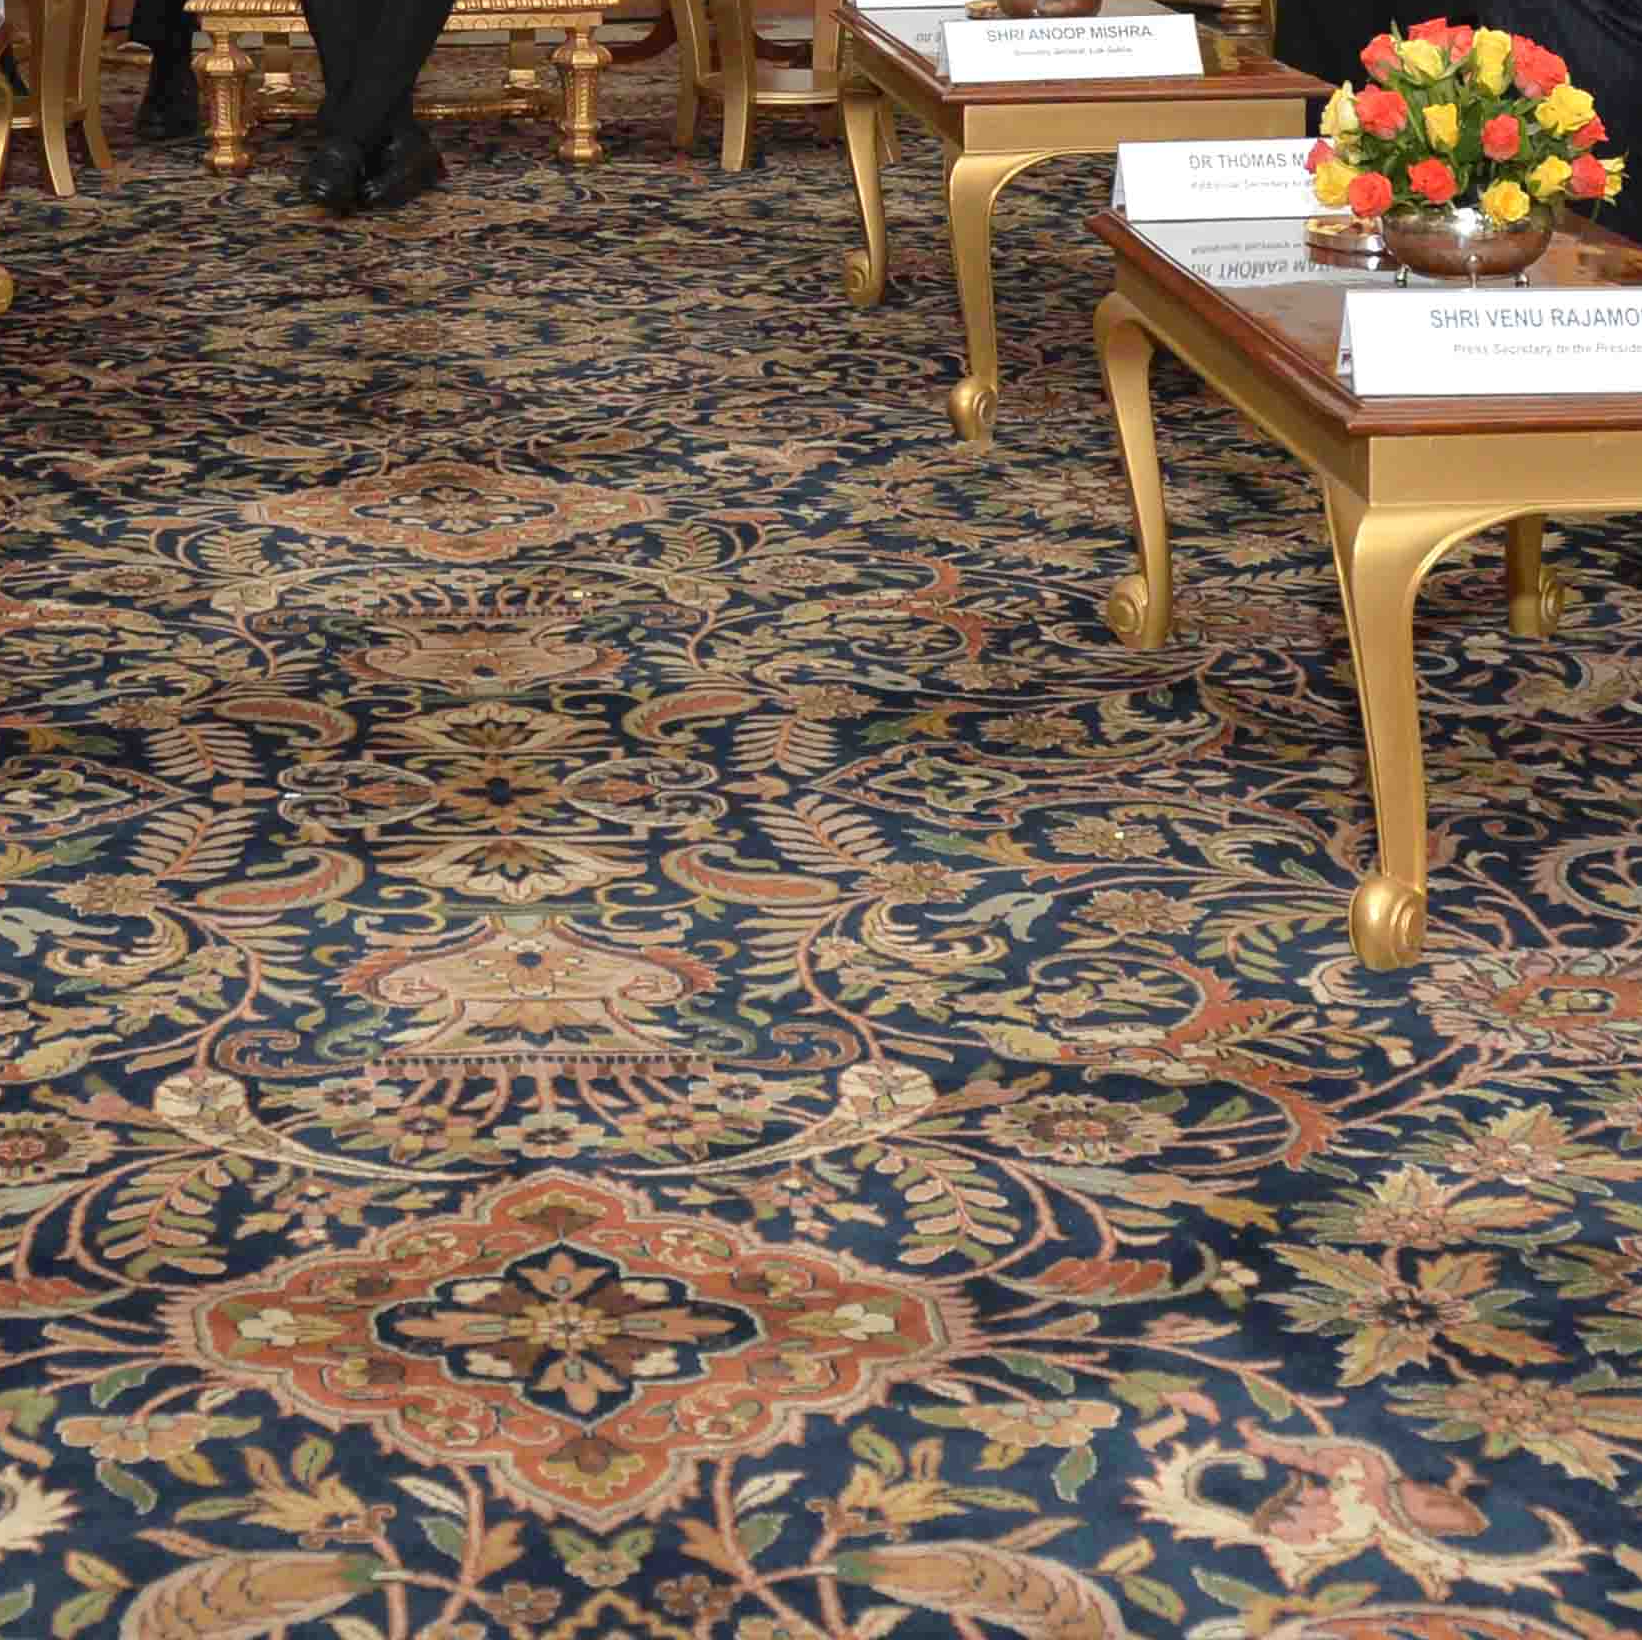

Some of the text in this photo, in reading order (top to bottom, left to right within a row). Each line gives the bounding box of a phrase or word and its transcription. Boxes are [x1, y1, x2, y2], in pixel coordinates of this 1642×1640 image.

[986, 24, 1153, 43] SHRI ANOOP MISHRA
[1189, 154, 1213, 169] DR
[1217, 152, 1287, 168] THOMAS
[1430, 308, 1480, 328] SHRI
[1484, 308, 1543, 328] VENU
